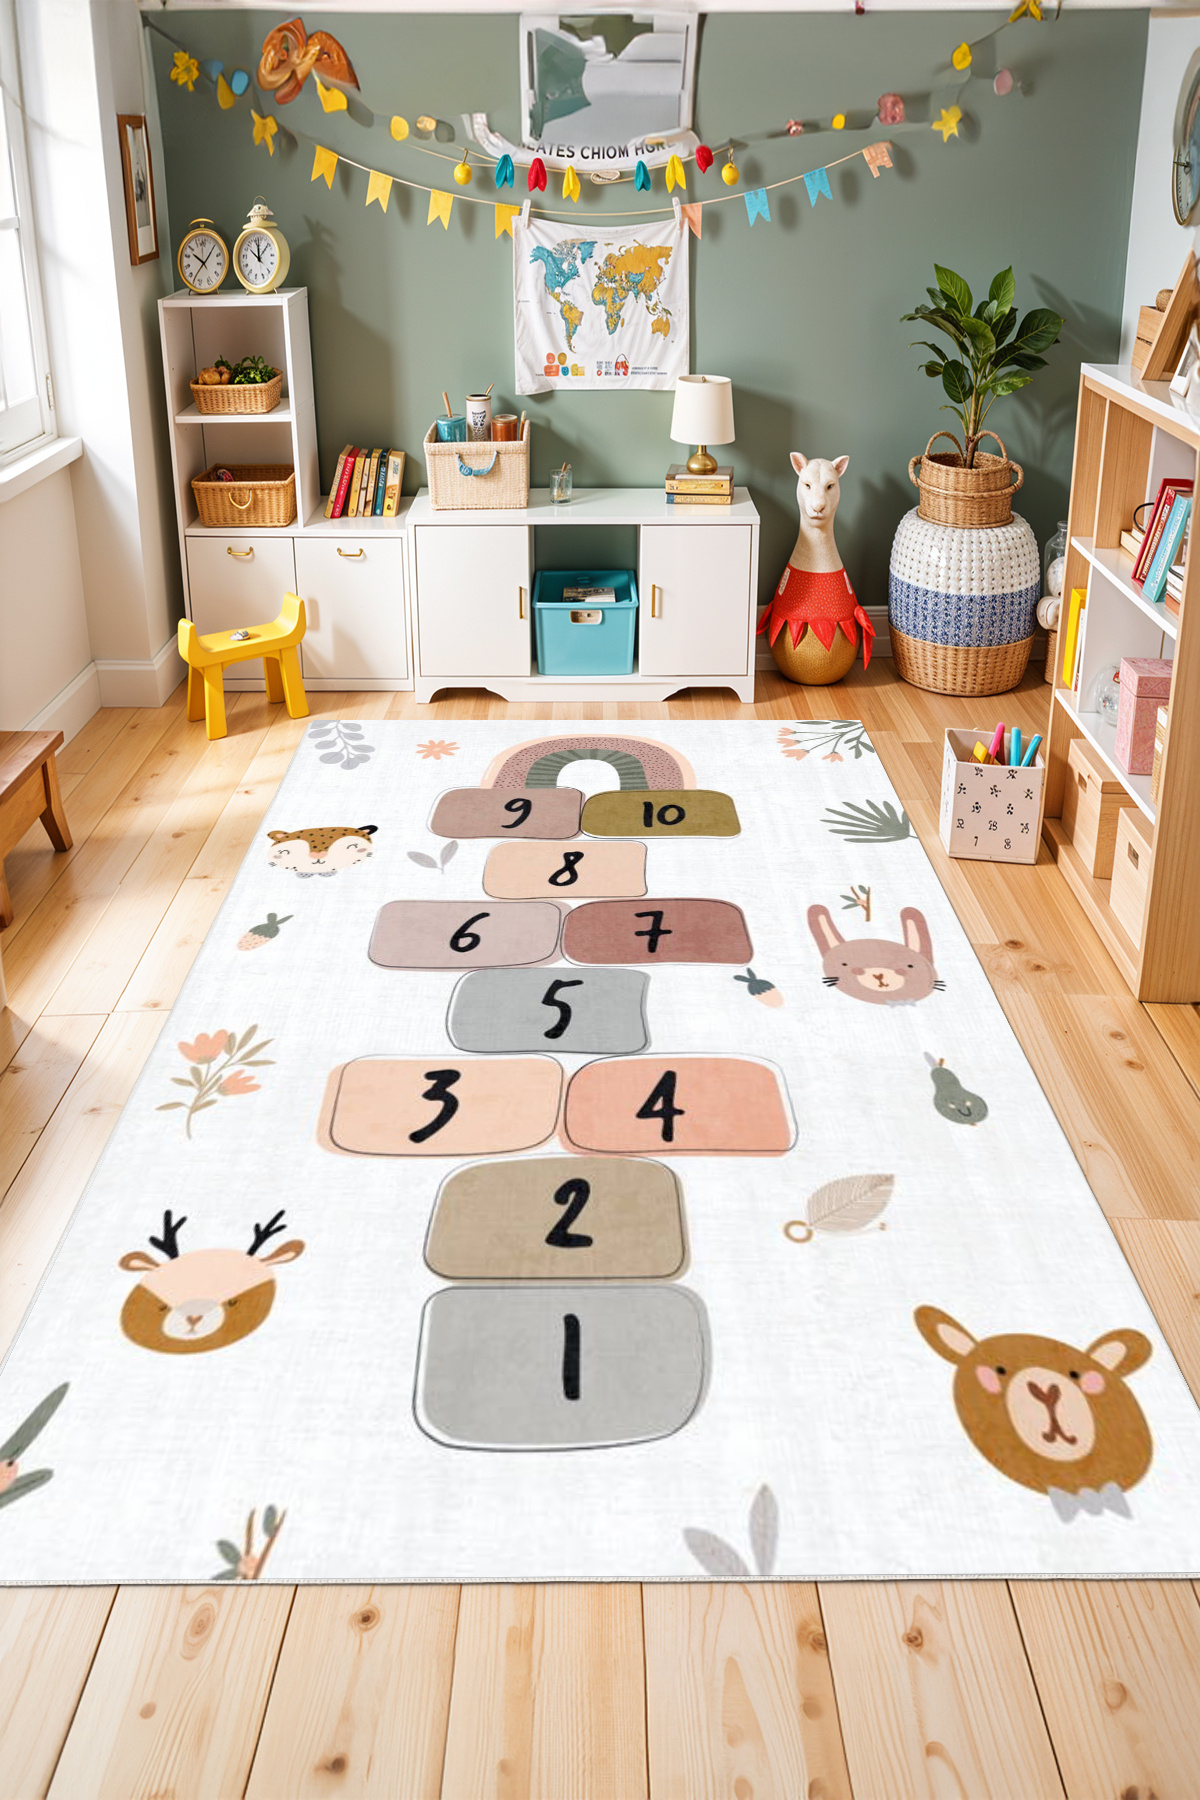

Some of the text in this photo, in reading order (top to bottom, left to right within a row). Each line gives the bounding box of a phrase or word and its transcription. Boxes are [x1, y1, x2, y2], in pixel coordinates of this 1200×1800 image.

[580, 145, 629, 160] CHIOM
[501, 798, 532, 829] 9
[642, 801, 686, 828] 10
[548, 851, 584, 887] 8
[449, 912, 490, 953] 6
[634, 910, 673, 954] 7
[541, 979, 584, 1040] 5
[409, 1069, 461, 1144] 3
[636, 1070, 685, 1142] 4
[545, 1178, 593, 1248] 2
[562, 1313, 580, 1401] 1
